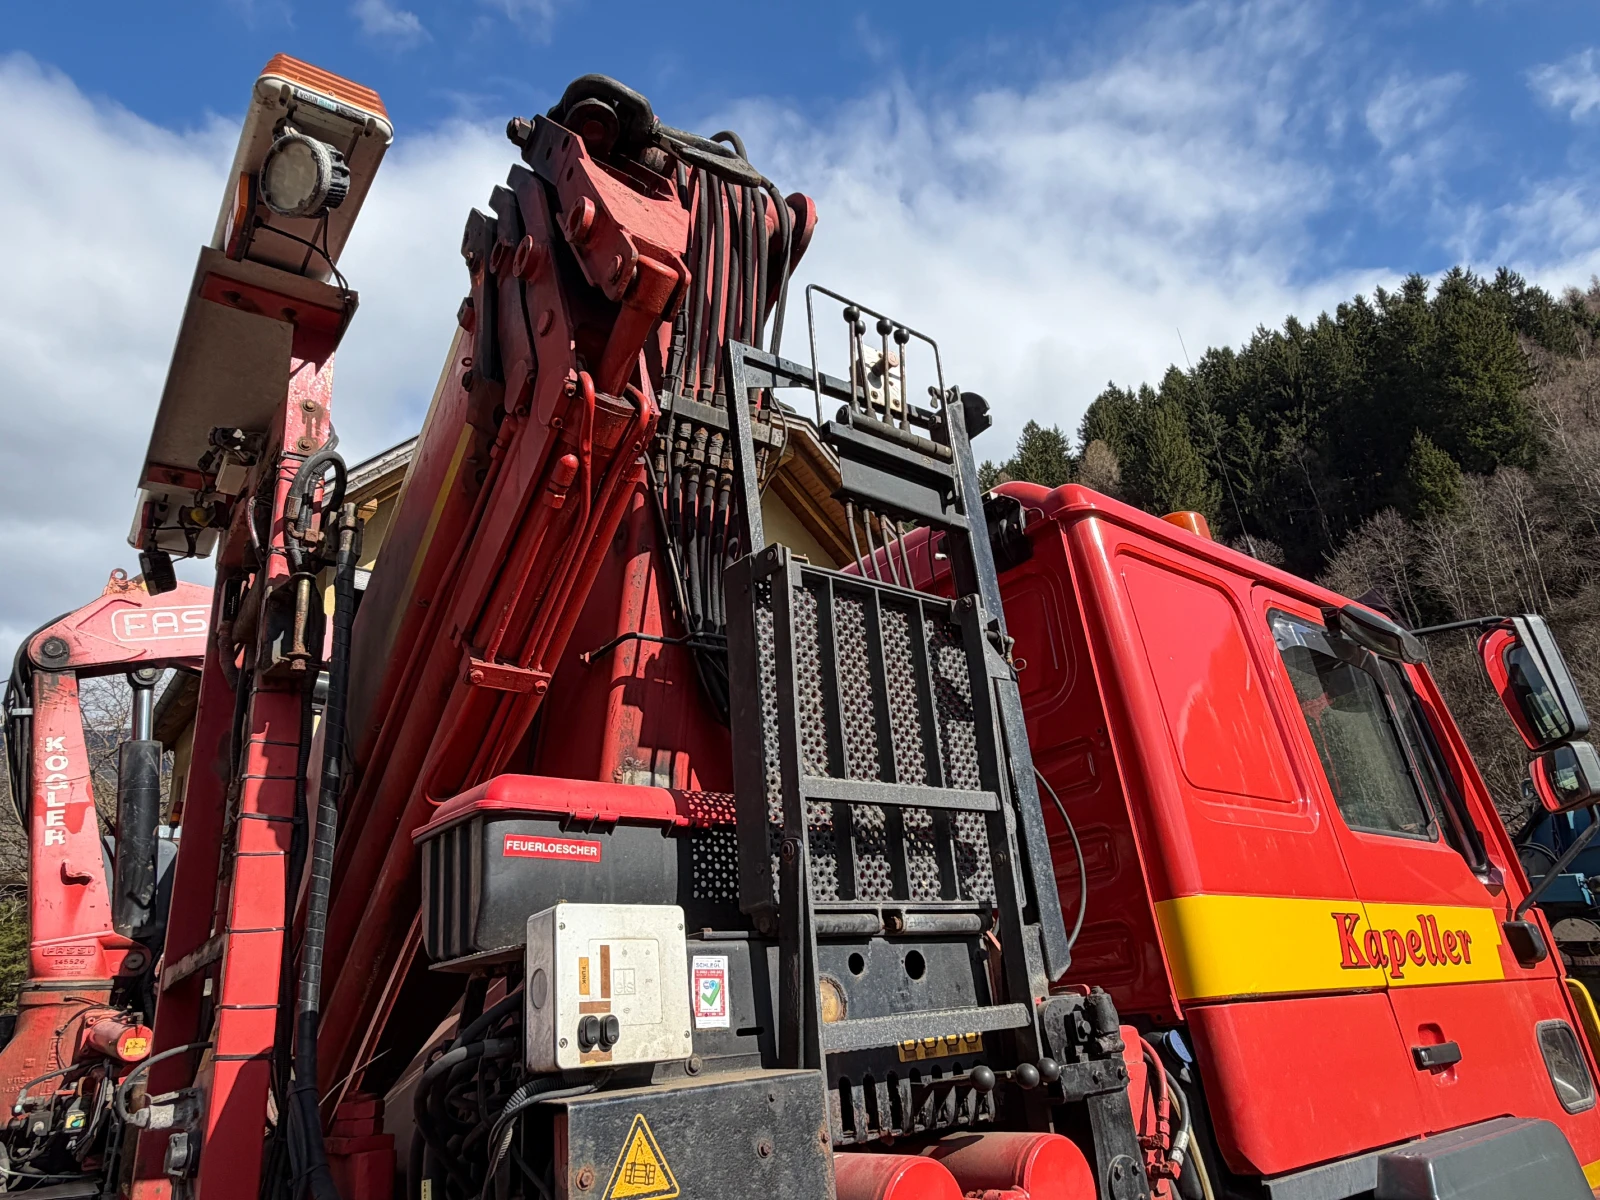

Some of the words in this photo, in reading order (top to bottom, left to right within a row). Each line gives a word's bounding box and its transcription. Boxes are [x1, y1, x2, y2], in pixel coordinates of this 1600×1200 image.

[45, 736, 69, 846] KOGLER
[506, 840, 598, 856] FEUERLOESCHER
[1331, 912, 1472, 979] Kapeller
